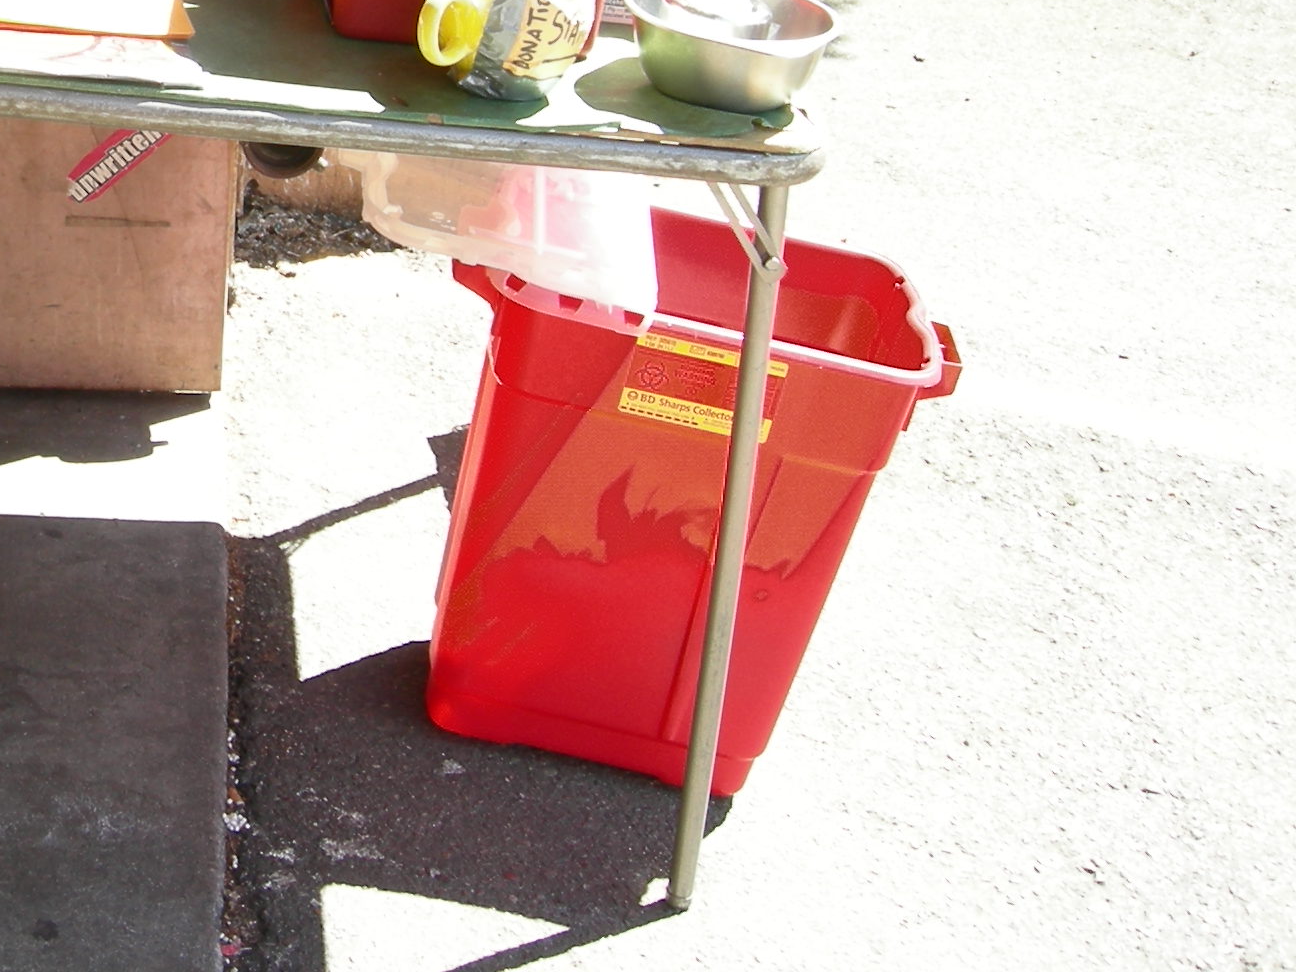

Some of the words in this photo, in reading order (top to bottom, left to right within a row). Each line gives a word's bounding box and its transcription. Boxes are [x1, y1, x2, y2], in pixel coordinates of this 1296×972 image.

[640, 394, 656, 404] BD
[659, 398, 690, 412] Sharps
[693, 403, 734, 421] Collecto
